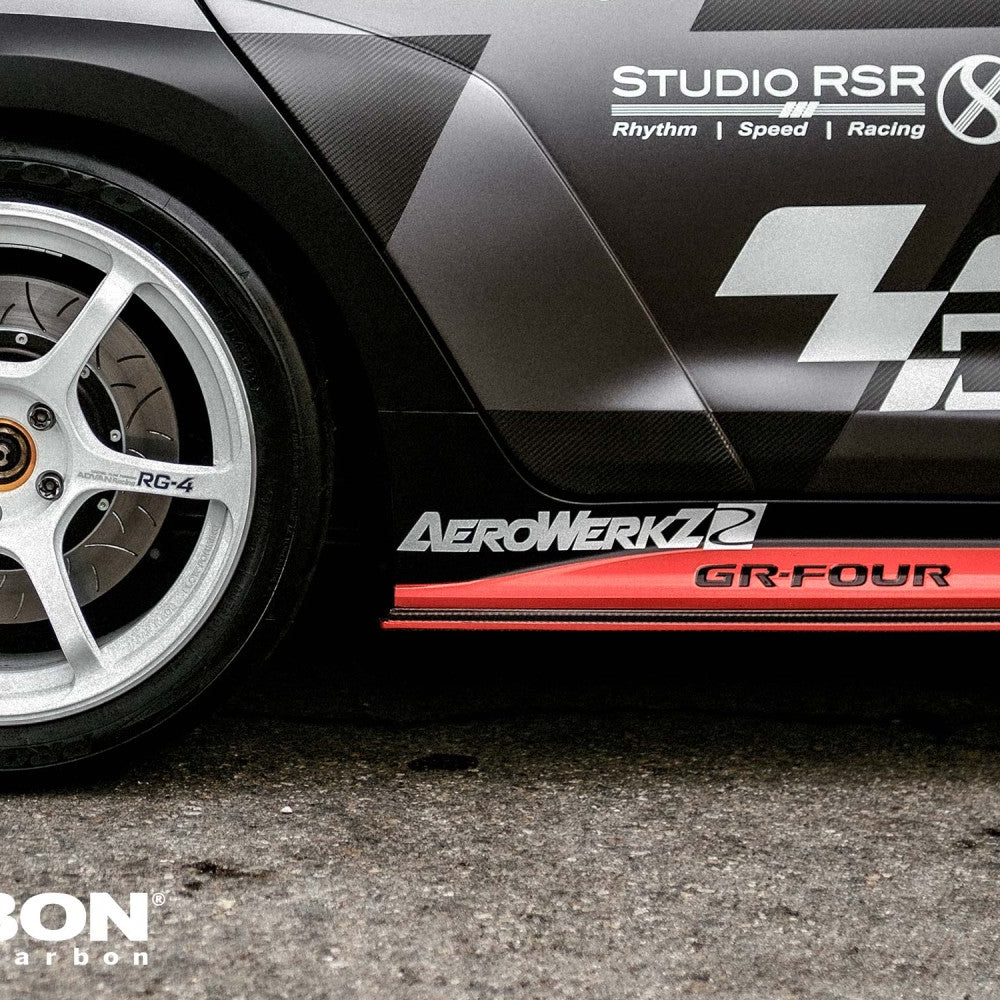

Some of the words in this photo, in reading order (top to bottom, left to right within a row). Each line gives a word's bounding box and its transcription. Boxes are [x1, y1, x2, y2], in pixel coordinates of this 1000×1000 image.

[612, 65, 799, 98] STUDIO
[813, 65, 926, 97] RSR
[612, 121, 698, 140] Rhythm
[738, 121, 809, 138] Speed
[847, 121, 926, 140] Racing
[137, 471, 196, 492] RG-4
[695, 564, 951, 588] GR-FOUR
